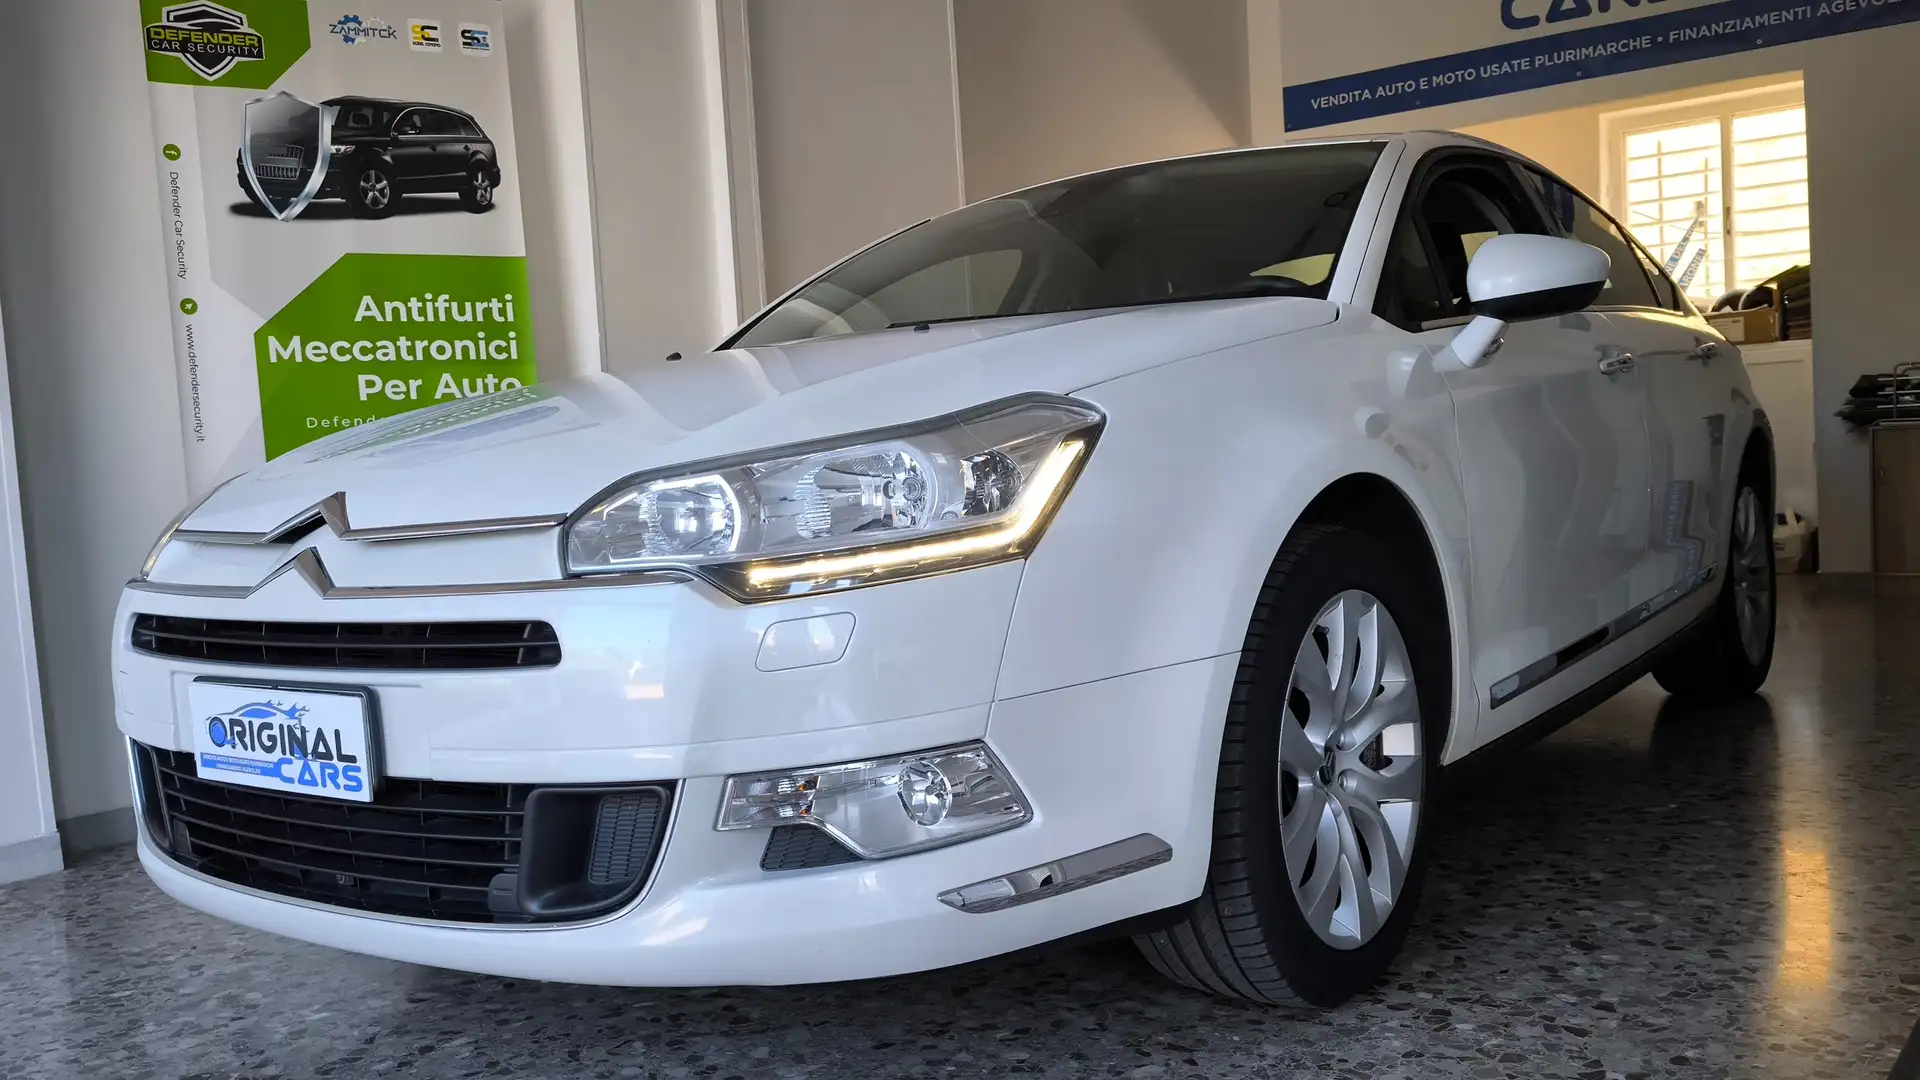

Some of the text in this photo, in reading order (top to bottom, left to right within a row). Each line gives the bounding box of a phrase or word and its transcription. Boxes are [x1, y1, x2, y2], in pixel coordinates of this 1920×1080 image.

[1501, 0, 1668, 30] CA
[149, 27, 259, 47] DEFENDER
[151, 39, 260, 56] CAR SECURITY
[1311, 0, 1900, 110] VENDITA AUTO E MOTO USATE PLURIMARCHE FINANZIAMENTI AGEV
[169, 171, 188, 280] Defender Car Security
[354, 293, 515, 322] Antifurti
[267, 331, 519, 363] Meccatronici
[186, 324, 206, 443] www.defendersecurity.it
[357, 373, 522, 401] Per Auto
[306, 415, 385, 428] Defend
[208, 716, 358, 764] ORIGINAL
[277, 757, 363, 793] CARS
